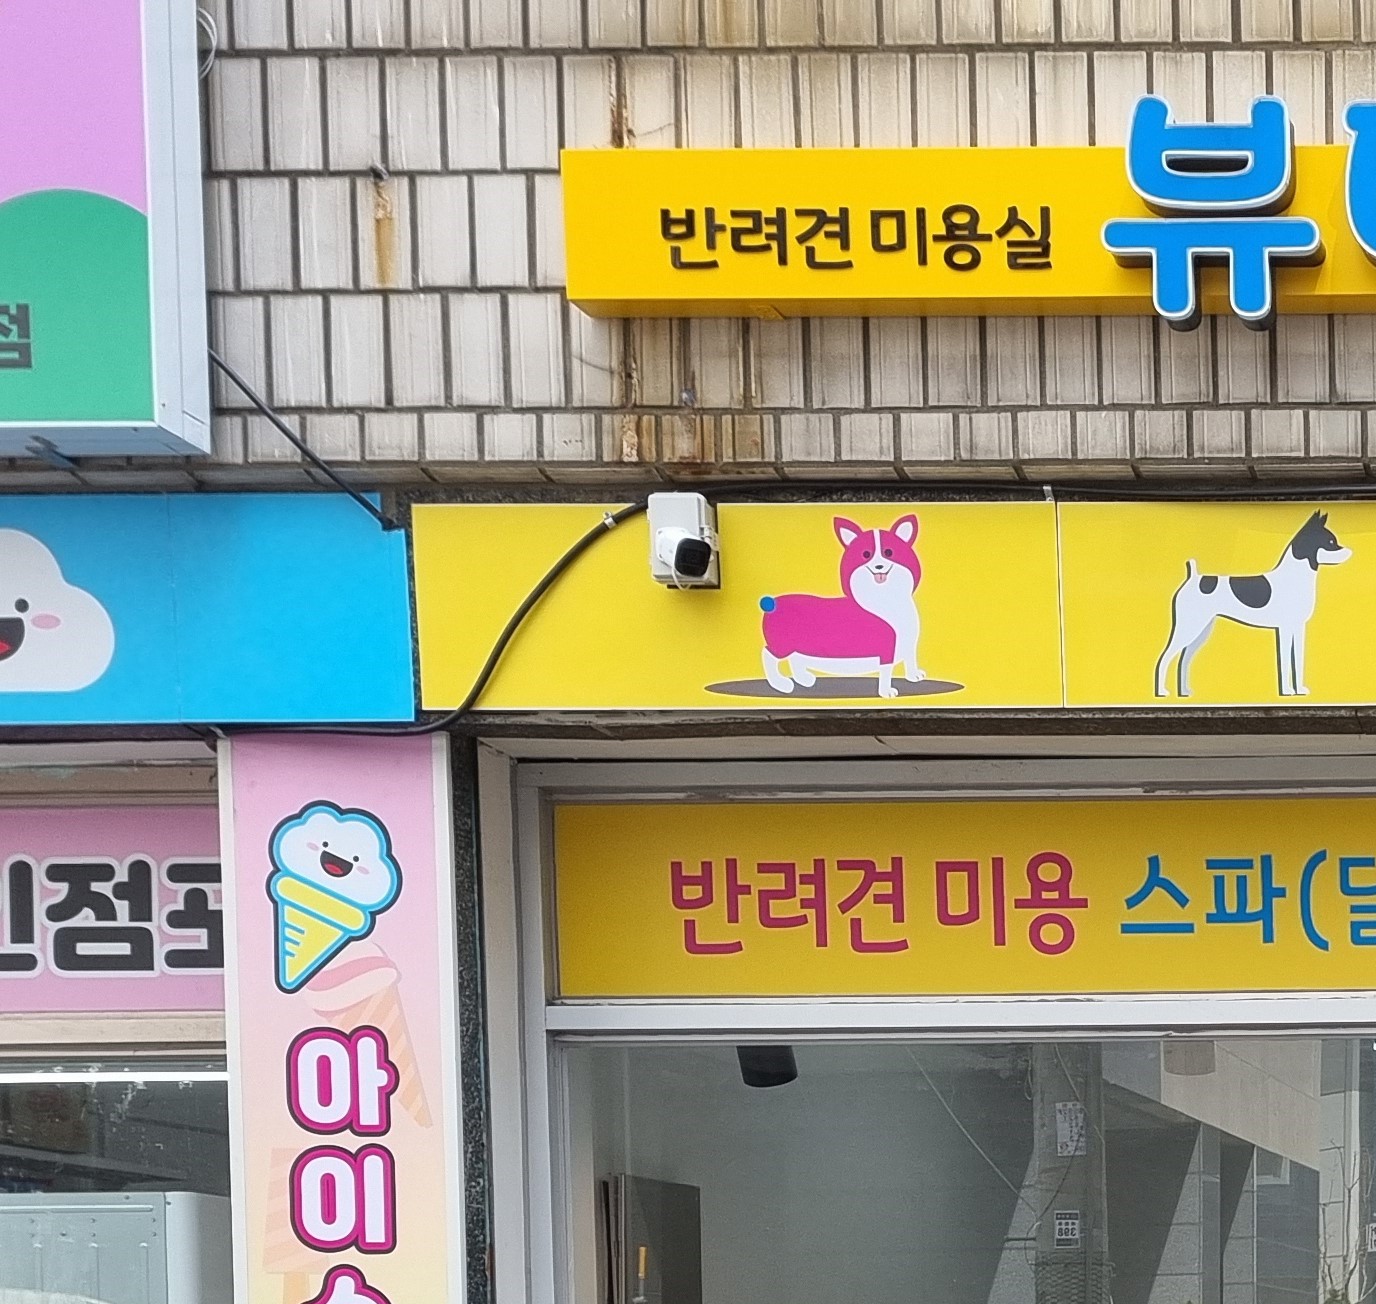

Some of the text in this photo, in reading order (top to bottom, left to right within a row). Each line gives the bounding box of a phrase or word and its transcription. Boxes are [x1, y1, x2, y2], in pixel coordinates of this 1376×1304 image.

[660, 204, 1053, 272] 반려견 미용실
[671, 854, 909, 955] 반려견
[936, 850, 1089, 955] 미용
